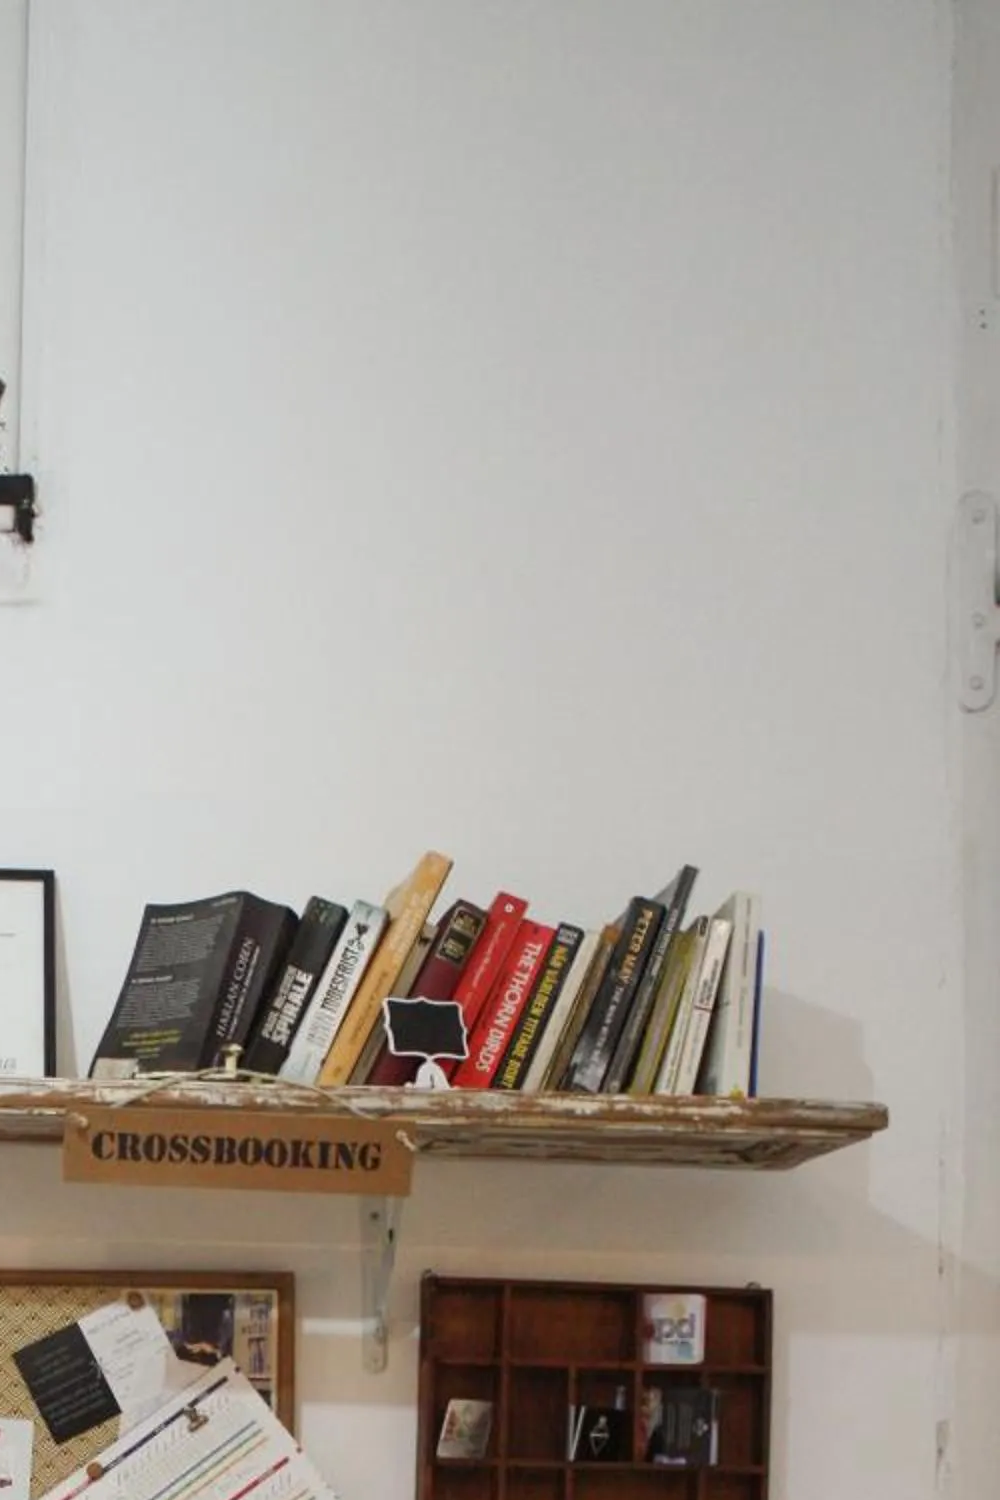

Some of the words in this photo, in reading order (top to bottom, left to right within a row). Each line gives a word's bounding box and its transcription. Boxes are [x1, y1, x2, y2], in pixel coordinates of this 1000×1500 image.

[630, 908, 653, 953] PETER
[518, 942, 542, 974] THE
[270, 969, 314, 1047] SPIRALE
[493, 971, 531, 1029] THORN
[476, 1028, 506, 1073] BIRDS
[91, 1130, 382, 1172] CROSSBOOKING
